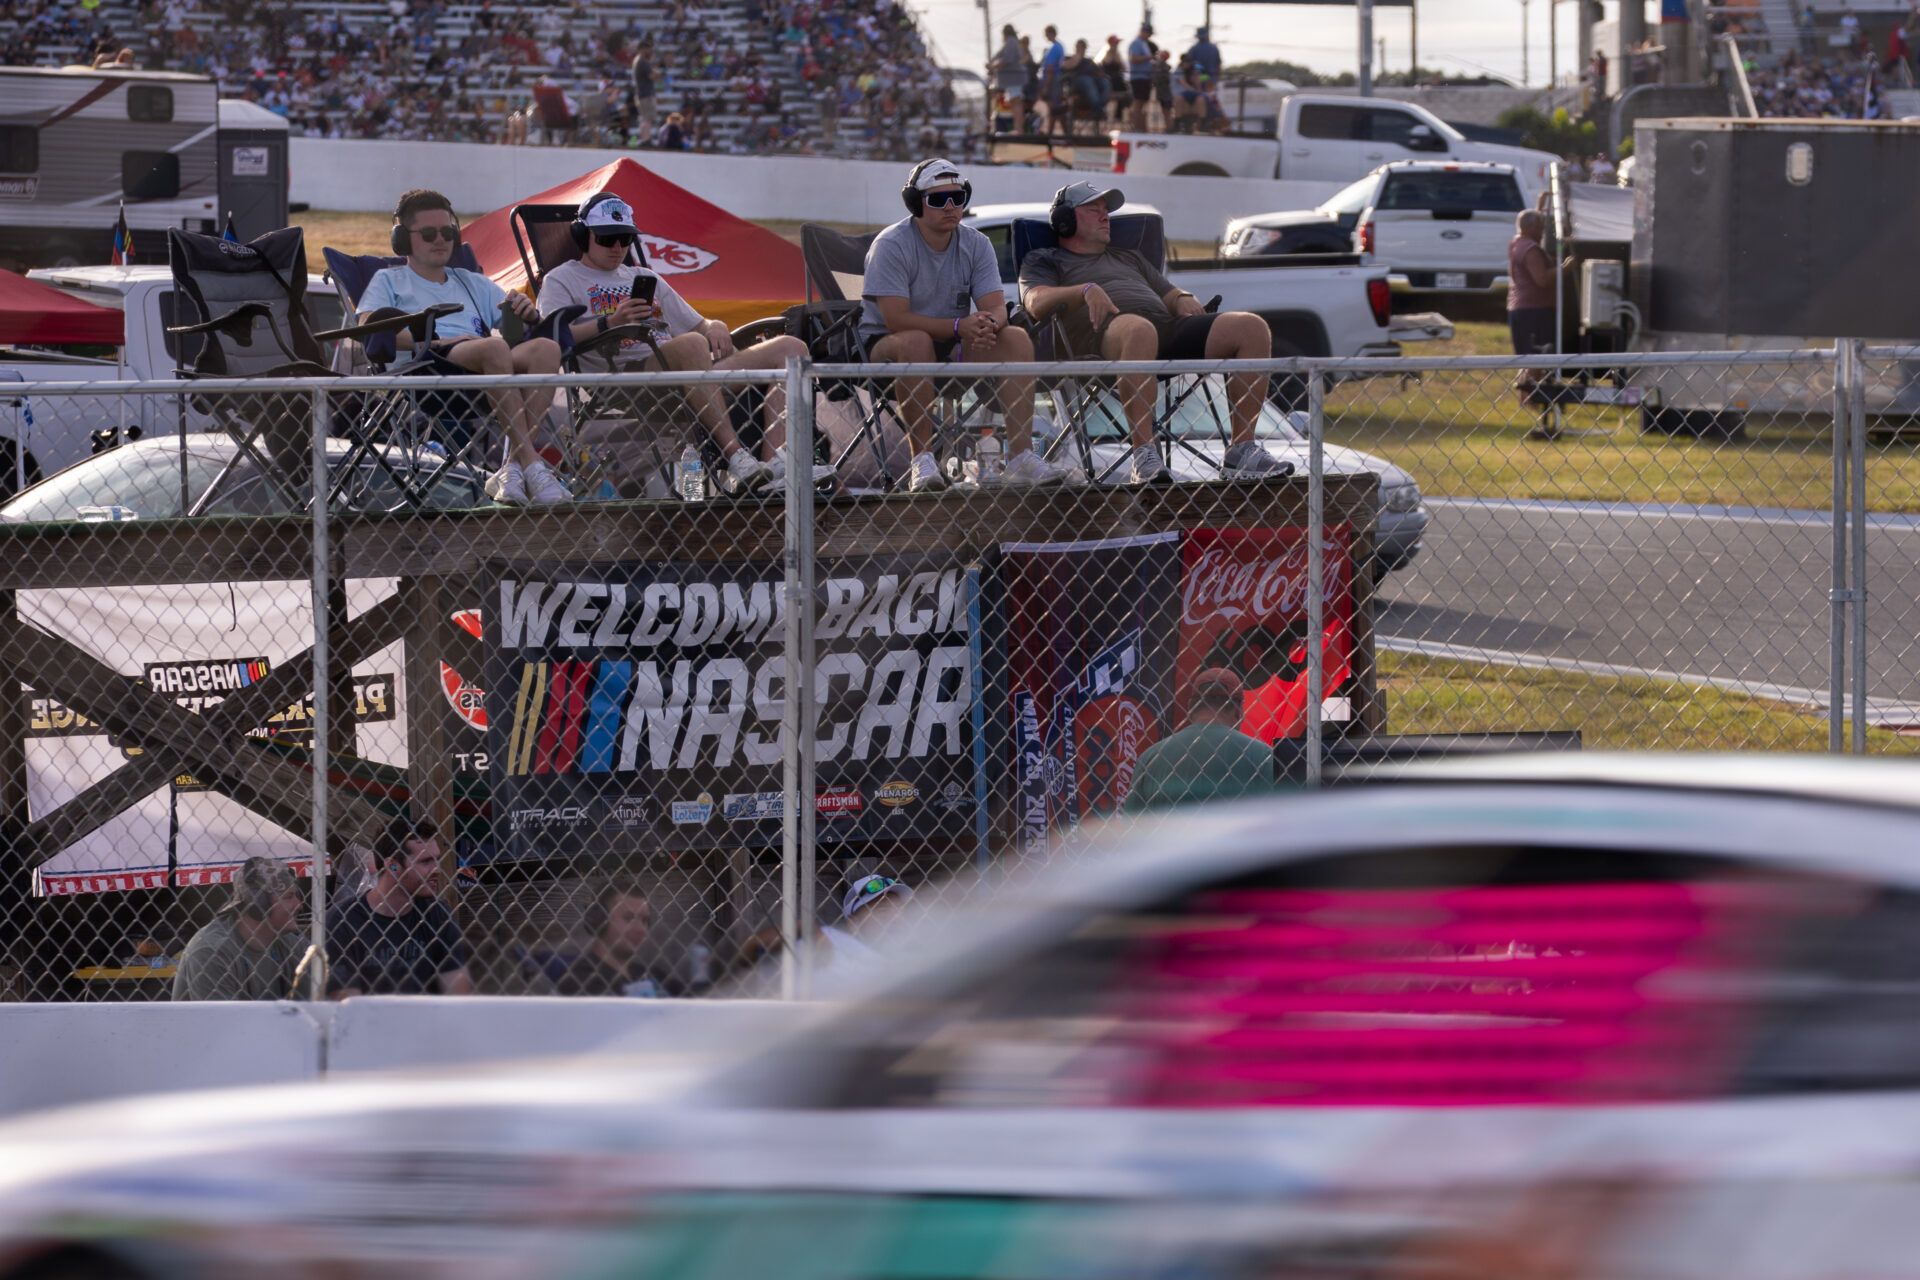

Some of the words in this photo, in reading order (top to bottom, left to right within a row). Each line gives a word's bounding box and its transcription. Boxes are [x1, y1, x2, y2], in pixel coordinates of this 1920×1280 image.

[618, 646, 971, 771] NASCAR
[1023, 699, 1041, 743] MAY
[814, 796, 859, 807] RAFTSMAN
[874, 789, 920, 798] MENARDS
[520, 807, 589, 821] TRACK
[612, 805, 649, 822] xfinity
[1025, 795, 1048, 854] 2025
